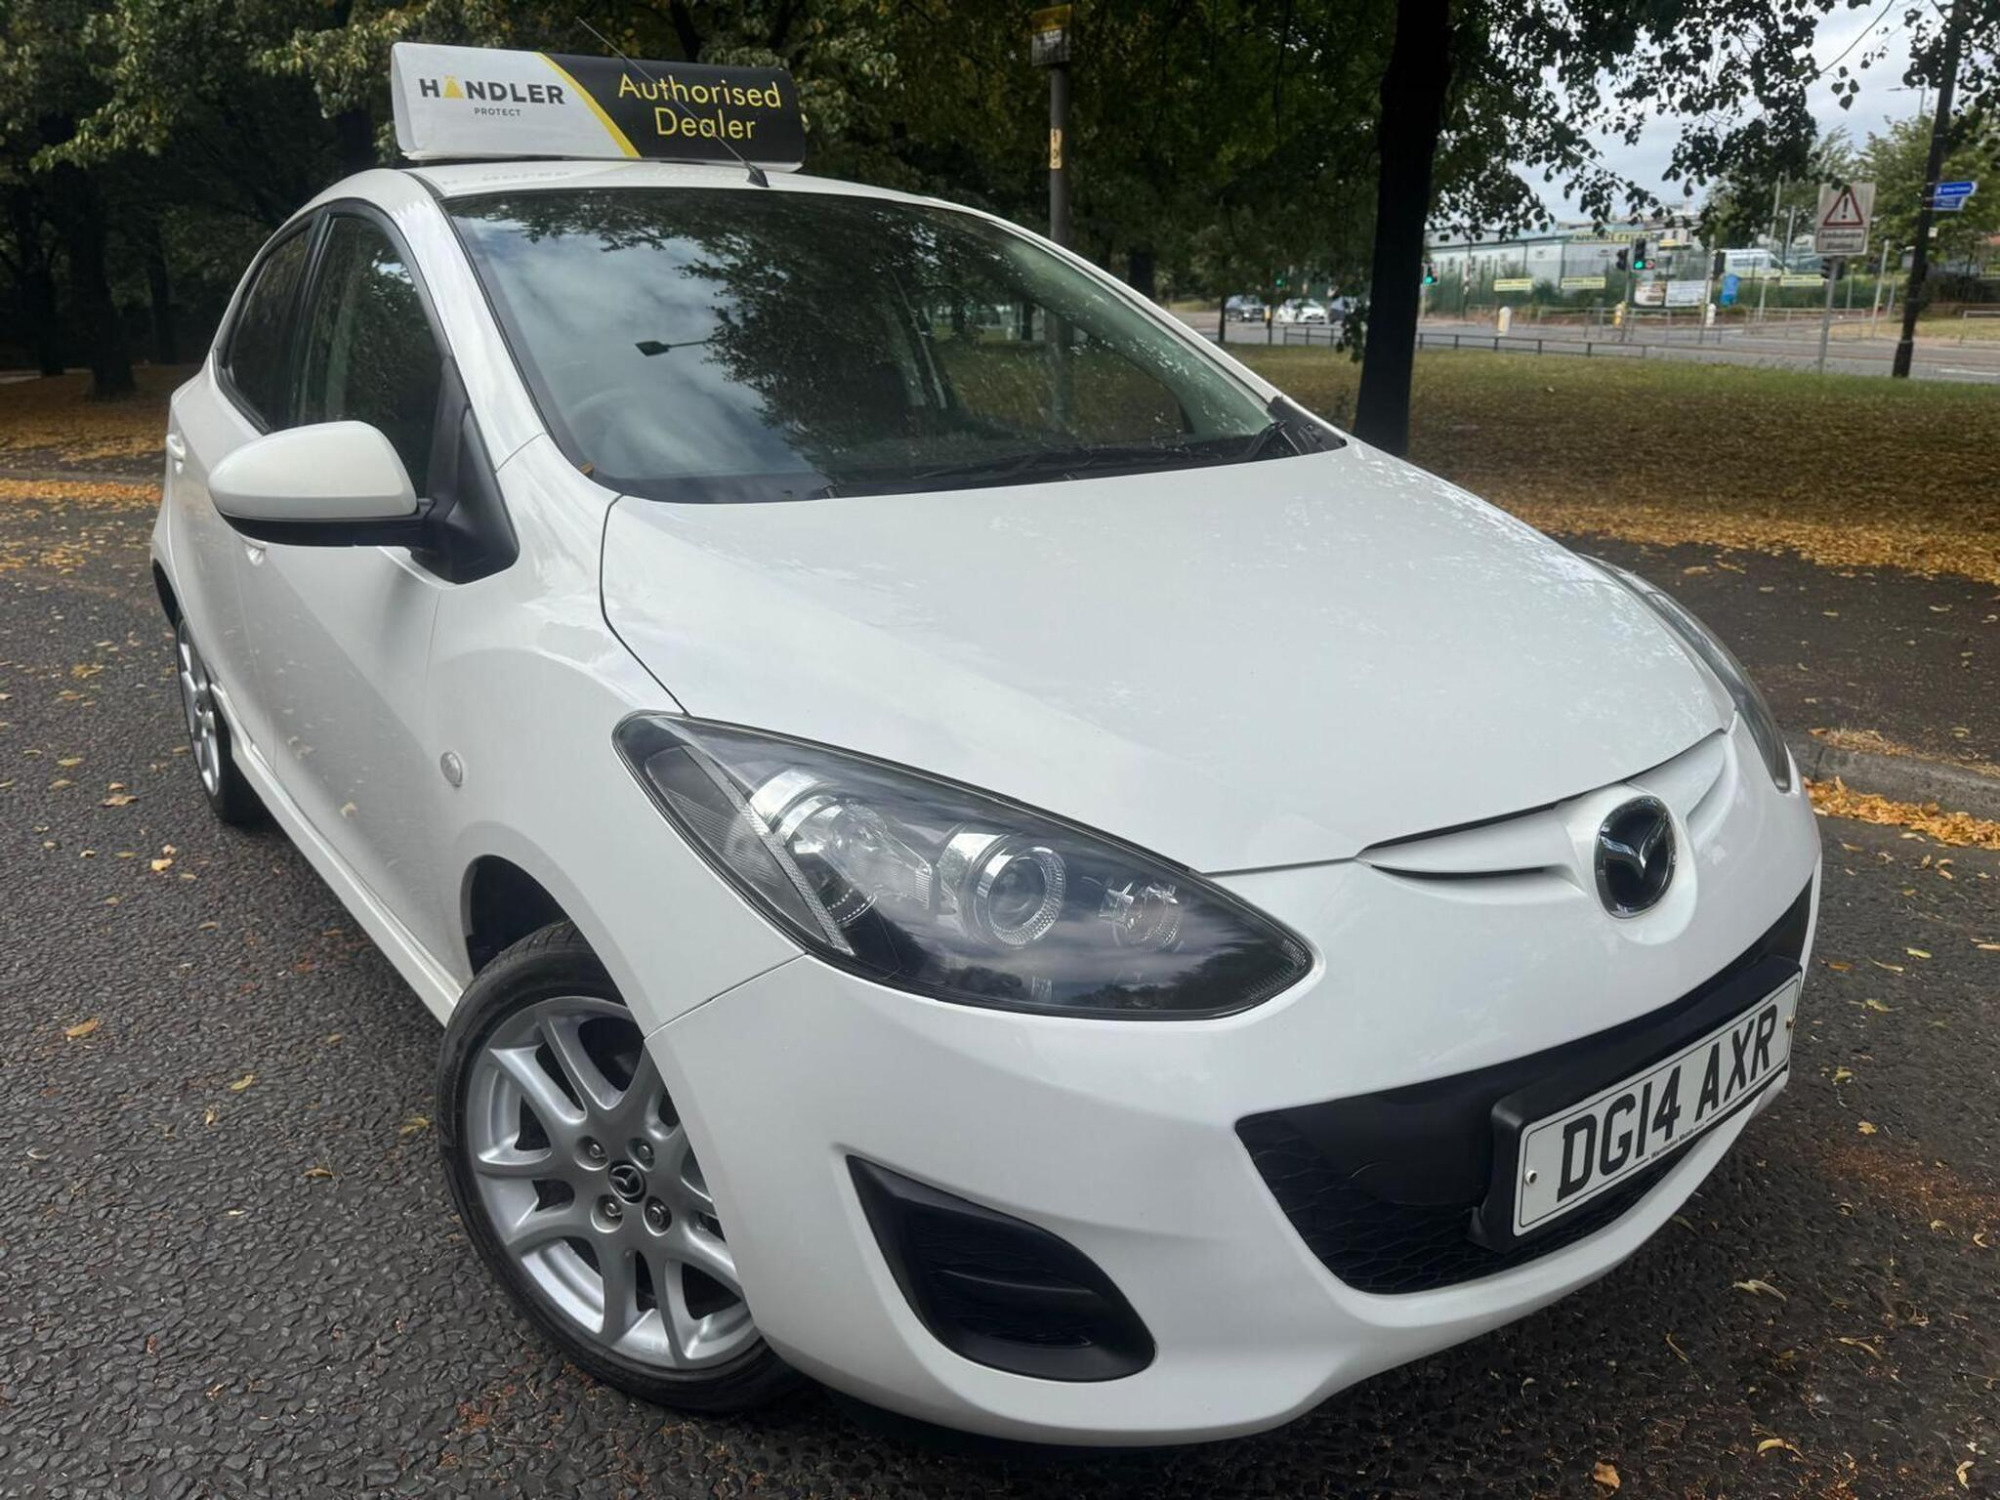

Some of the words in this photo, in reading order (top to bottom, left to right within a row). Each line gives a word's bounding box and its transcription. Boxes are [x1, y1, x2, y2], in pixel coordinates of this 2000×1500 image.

[618, 73, 781, 109] Authorised
[474, 107, 521, 116] PROTECT
[655, 107, 756, 139] Dealer
[1557, 1065, 1682, 1203] DG14
[1694, 1004, 1777, 1123] AXR
